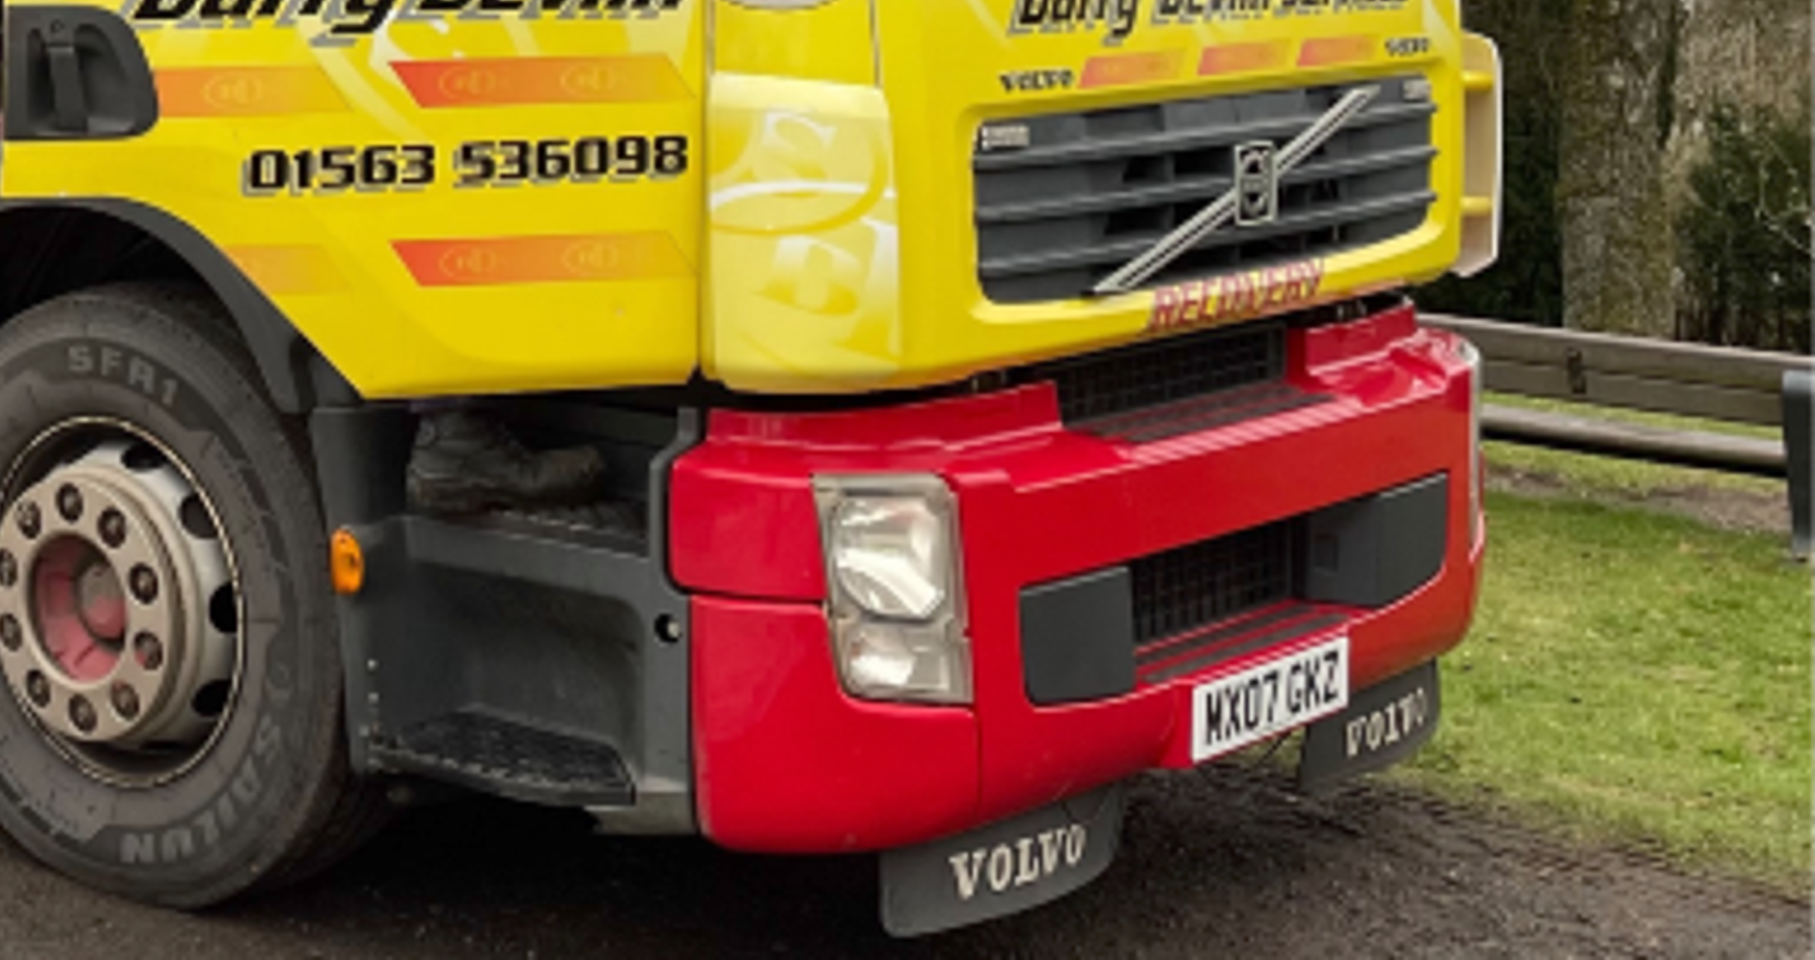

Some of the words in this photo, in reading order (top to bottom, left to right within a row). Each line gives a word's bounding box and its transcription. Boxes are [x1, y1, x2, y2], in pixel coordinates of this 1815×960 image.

[243, 143, 436, 196] 01563
[454, 135, 689, 189] 536098
[1148, 257, 1325, 327] RECOVERY
[67, 344, 178, 407] SFR1
[1206, 670, 1279, 746] MX07
[1287, 648, 1340, 715] GKZ
[1346, 687, 1429, 758] VOLVO
[120, 713, 282, 864] SAILUN
[948, 823, 1085, 900] VOLVO
